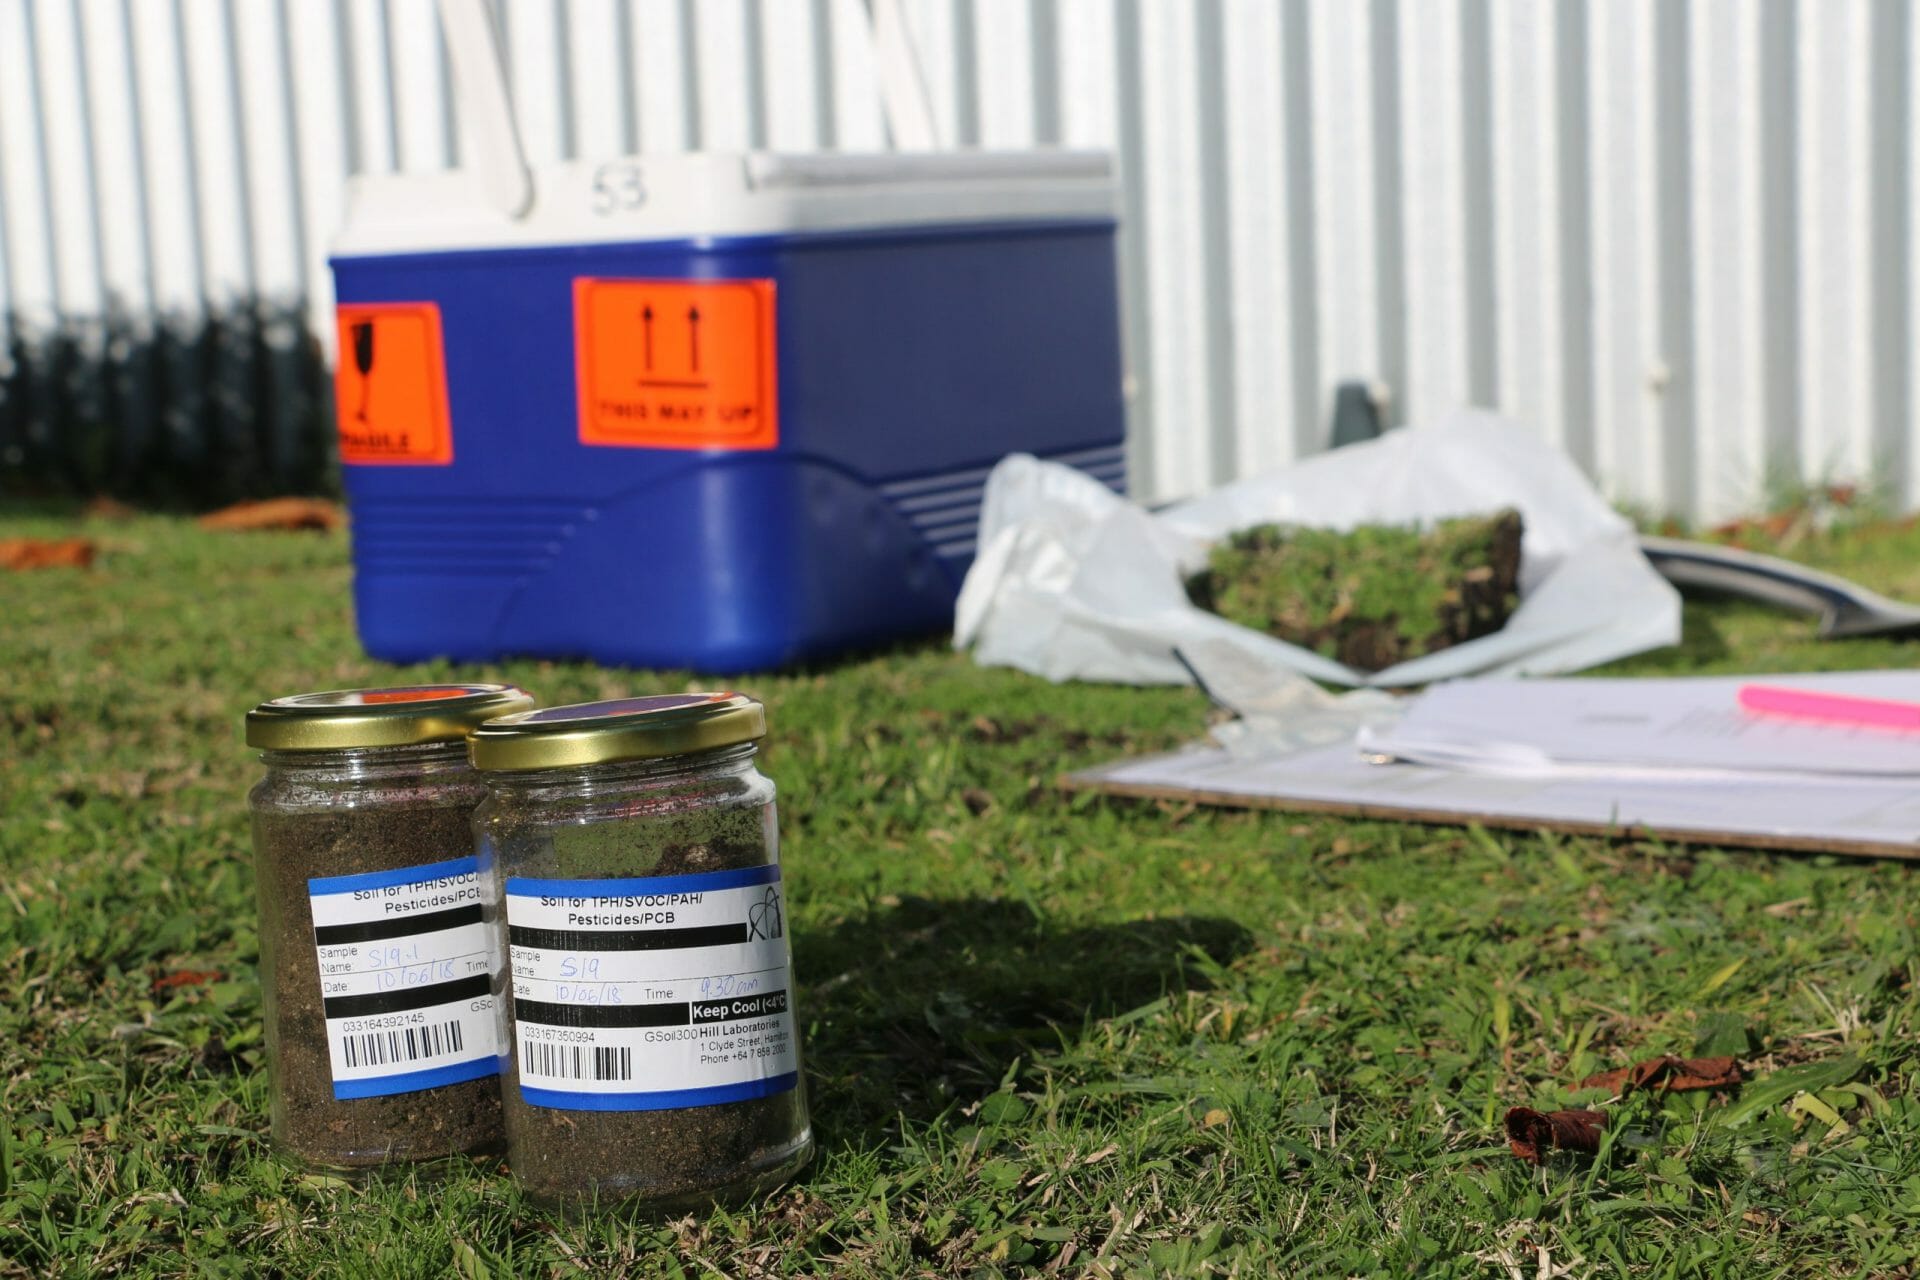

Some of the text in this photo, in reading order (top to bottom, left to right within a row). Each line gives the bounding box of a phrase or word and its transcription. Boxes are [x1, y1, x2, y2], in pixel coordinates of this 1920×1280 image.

[354, 890, 379, 901] Soil
[384, 886, 402, 897] for
[541, 892, 704, 908] Soil for TPH/SVOC/PAH/
[568, 911, 675, 926] Pesticides/PCB
[320, 946, 358, 960] Sample
[511, 947, 541, 962] Sample
[645, 988, 674, 1000] Time
[693, 1004, 729, 1019] Keep
[732, 999, 760, 1014] Cool
[343, 1012, 425, 1032] 033164392145
[700, 1020, 780, 1038] Hill Laboratories
[525, 1026, 595, 1043] 033167350994
[644, 1028, 698, 1043] GSoil300
[709, 1040, 735, 1052] Clyde
[700, 1054, 729, 1064] Phone
[732, 1050, 747, 1061] +64
